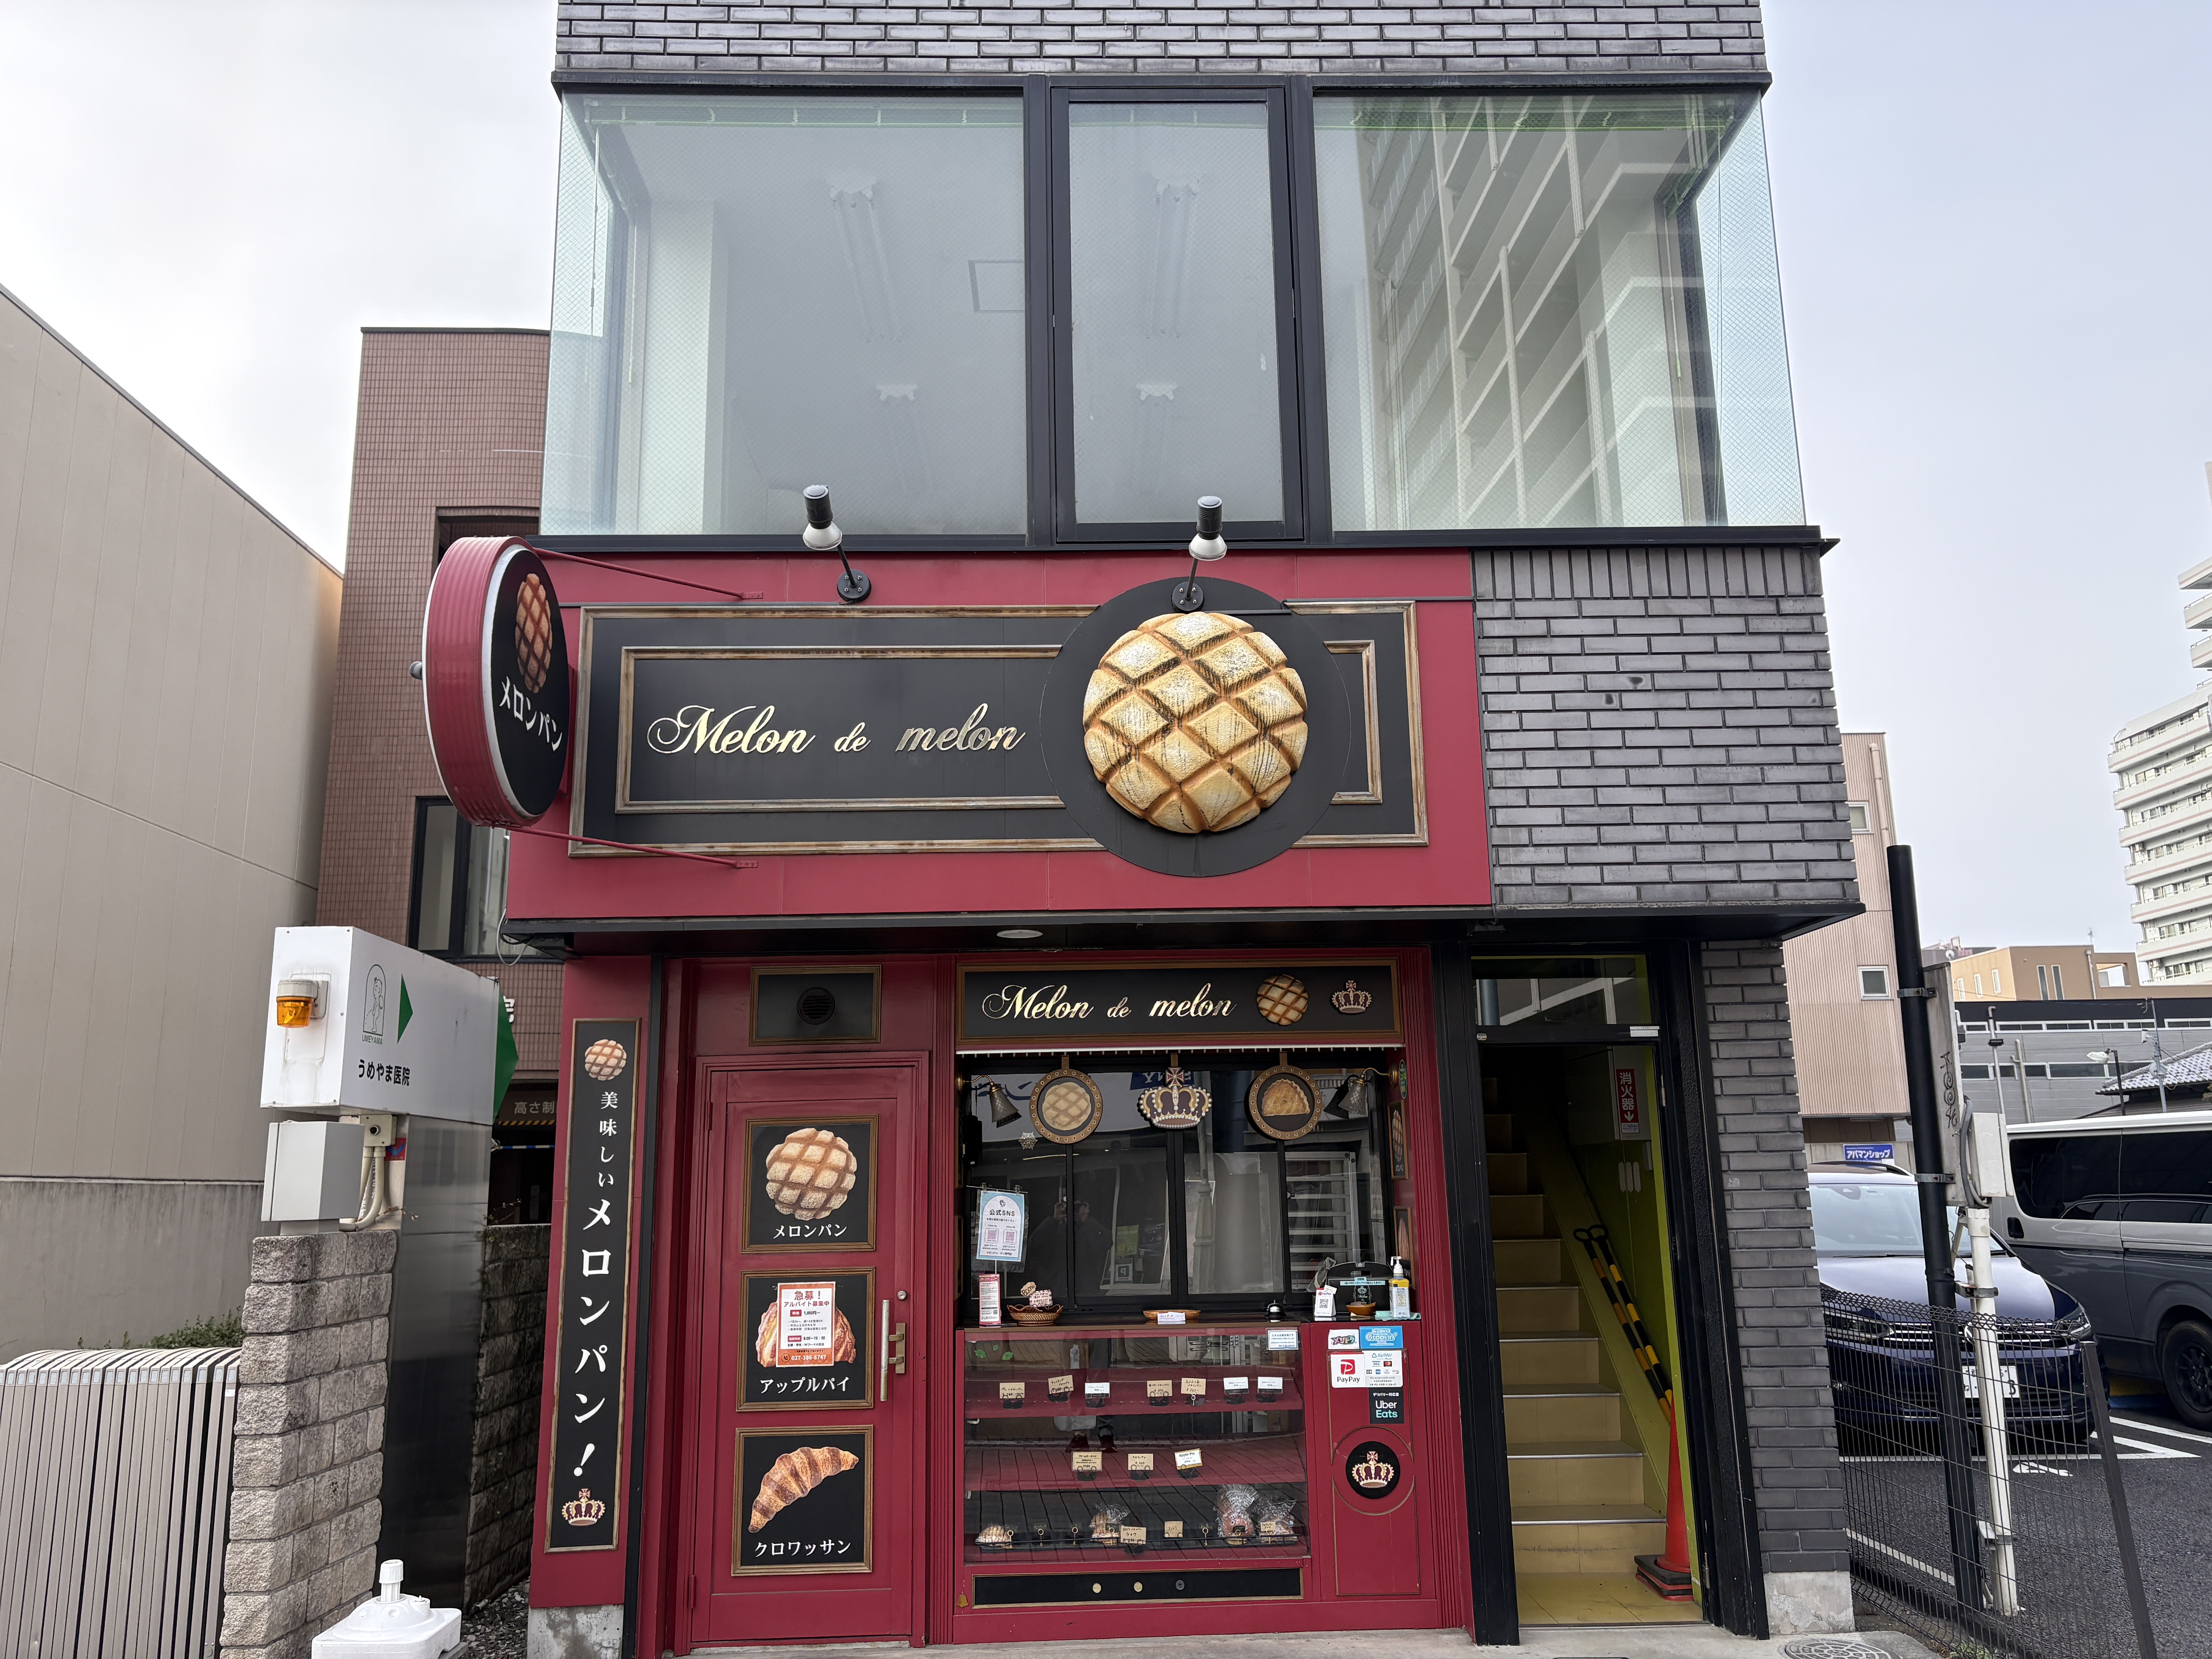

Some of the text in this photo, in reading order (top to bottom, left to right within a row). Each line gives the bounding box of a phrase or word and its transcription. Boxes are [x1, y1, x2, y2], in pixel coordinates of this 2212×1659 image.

[499, 676, 563, 751] メロンパン
[647, 703, 1026, 754] Melon de melon
[982, 982, 1237, 1019] Melon de melon
[362, 1034, 383, 1045] UMEYAMA
[359, 1059, 410, 1086] うめやま医院
[1620, 1072, 1634, 1110] 消火器
[773, 1223, 847, 1239] メロンパン
[760, 1377, 850, 1394] アップルパイ
[1376, 1400, 1397, 1409] Uber
[1376, 1410, 1398, 1418] Eats
[755, 1540, 851, 1558] クロワッサン
